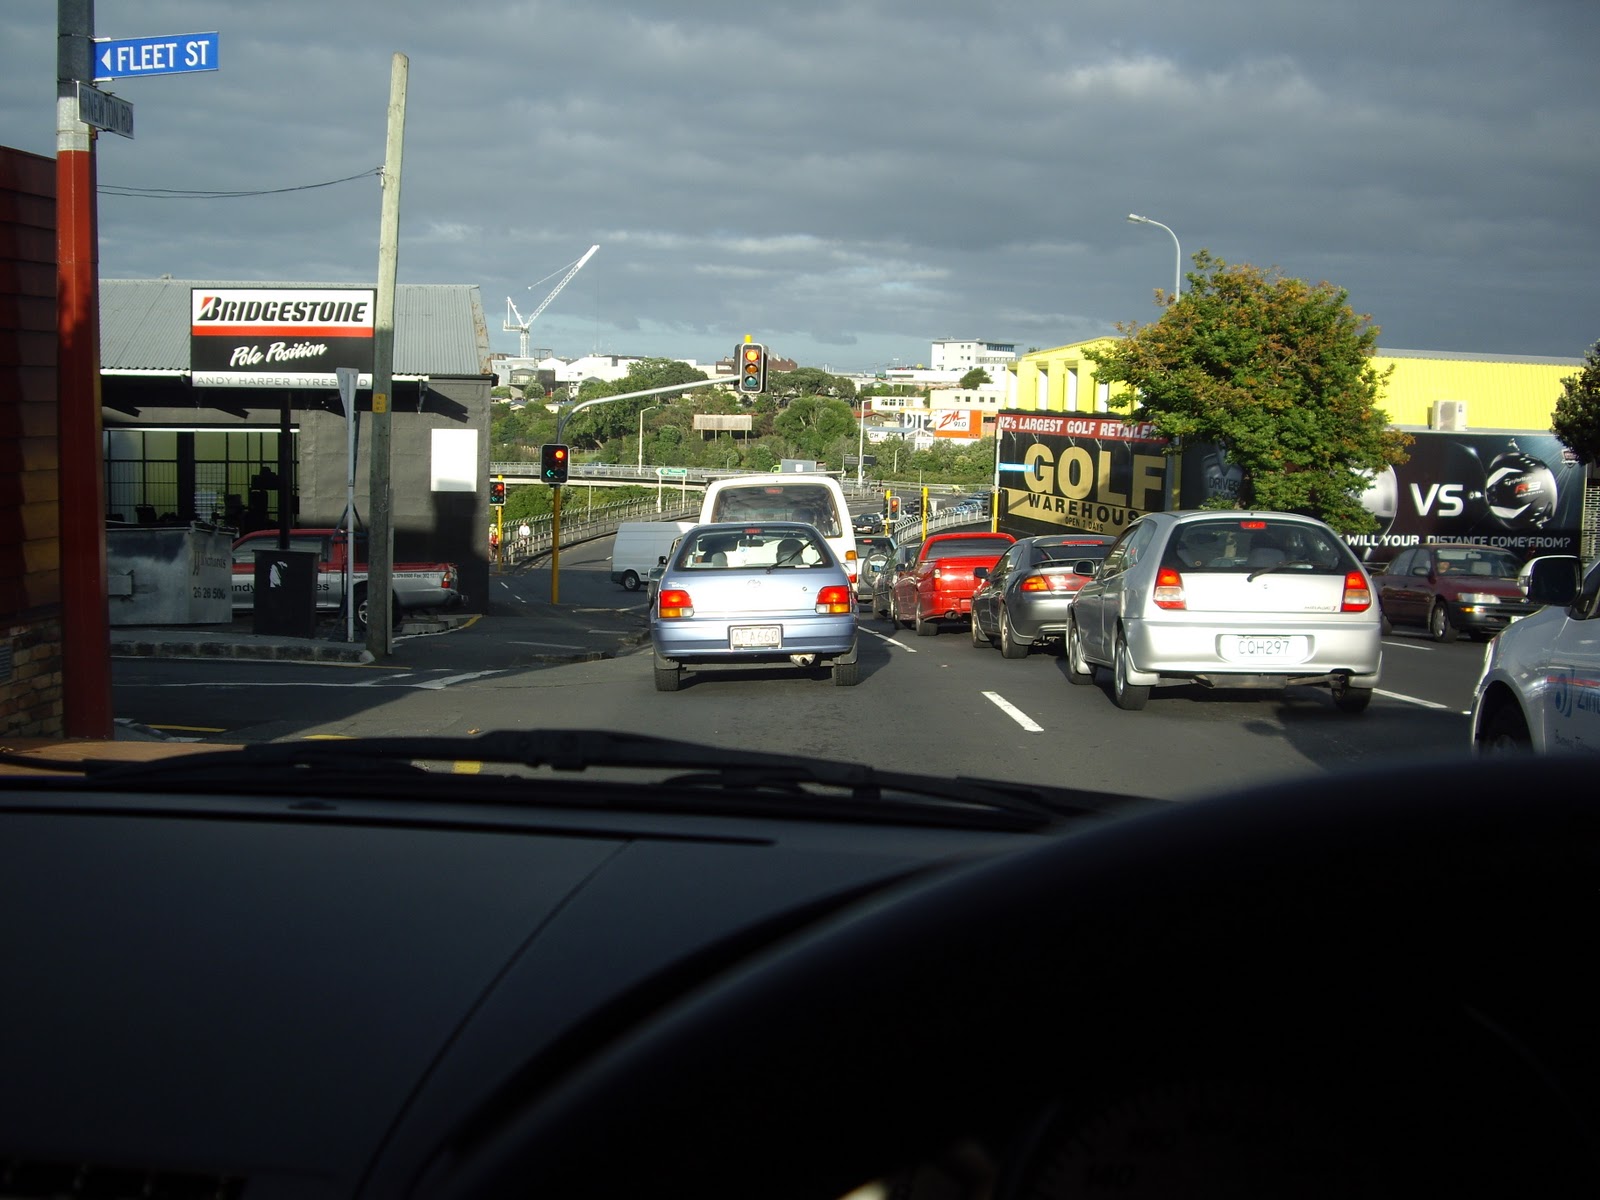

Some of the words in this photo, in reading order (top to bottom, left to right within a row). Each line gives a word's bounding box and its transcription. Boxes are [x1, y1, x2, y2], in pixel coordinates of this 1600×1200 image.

[117, 43, 178, 72] FLEET
[184, 40, 210, 67] ST
[87, 92, 119, 131] NEWTON
[198, 296, 368, 323] BRIDGESTONE
[229, 344, 264, 367] Pole
[265, 341, 328, 363] Position
[196, 376, 233, 385] ANDY
[238, 377, 291, 386] HARPER
[296, 377, 338, 387] TYRES
[1018, 418, 1064, 433] LARGEST
[1067, 420, 1096, 436] GOLF
[1024, 443, 1167, 511] GOLF
[1409, 482, 1465, 518] VS
[1064, 516, 1080, 527] OPEN
[1089, 521, 1104, 532] DAYS
[1346, 534, 1379, 547] WILL
[1382, 534, 1420, 547] YOUR
[1427, 535, 1488, 546] DISTANCE
[1490, 536, 1525, 548] COME
[1528, 536, 1571, 549] FROM?
[231, 583, 254, 594] ndy
